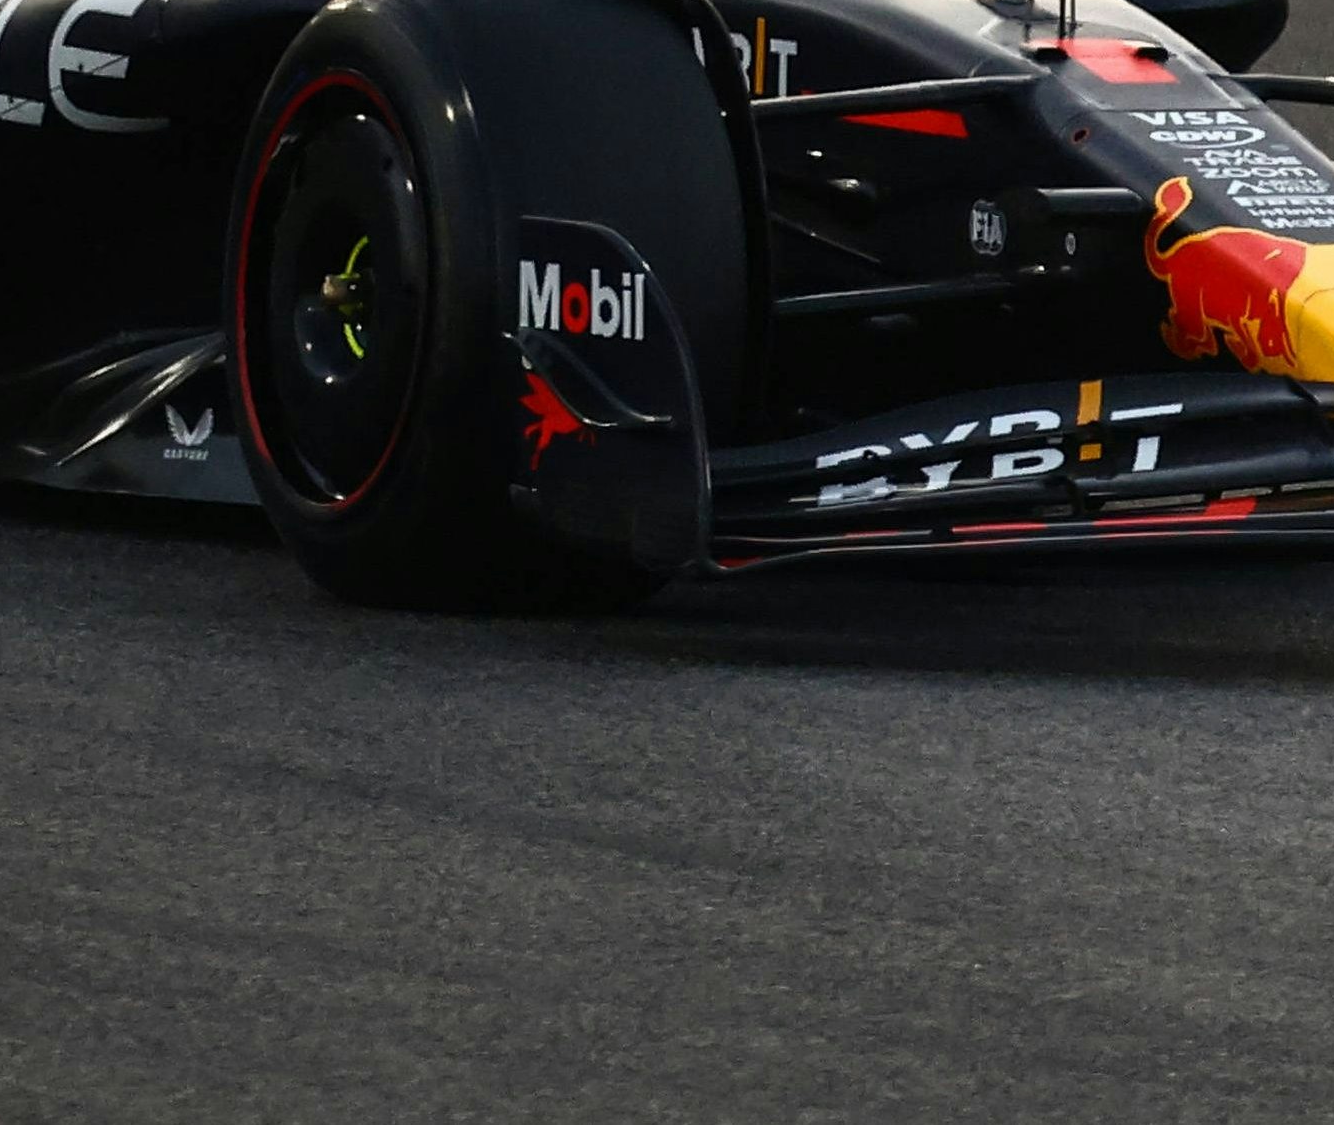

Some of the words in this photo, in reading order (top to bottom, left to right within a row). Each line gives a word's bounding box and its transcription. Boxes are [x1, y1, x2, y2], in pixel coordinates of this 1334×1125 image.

[1128, 111, 1249, 125] VISA
[519, 260, 645, 341] Mobil
[816, 379, 1184, 507] BYBIT
